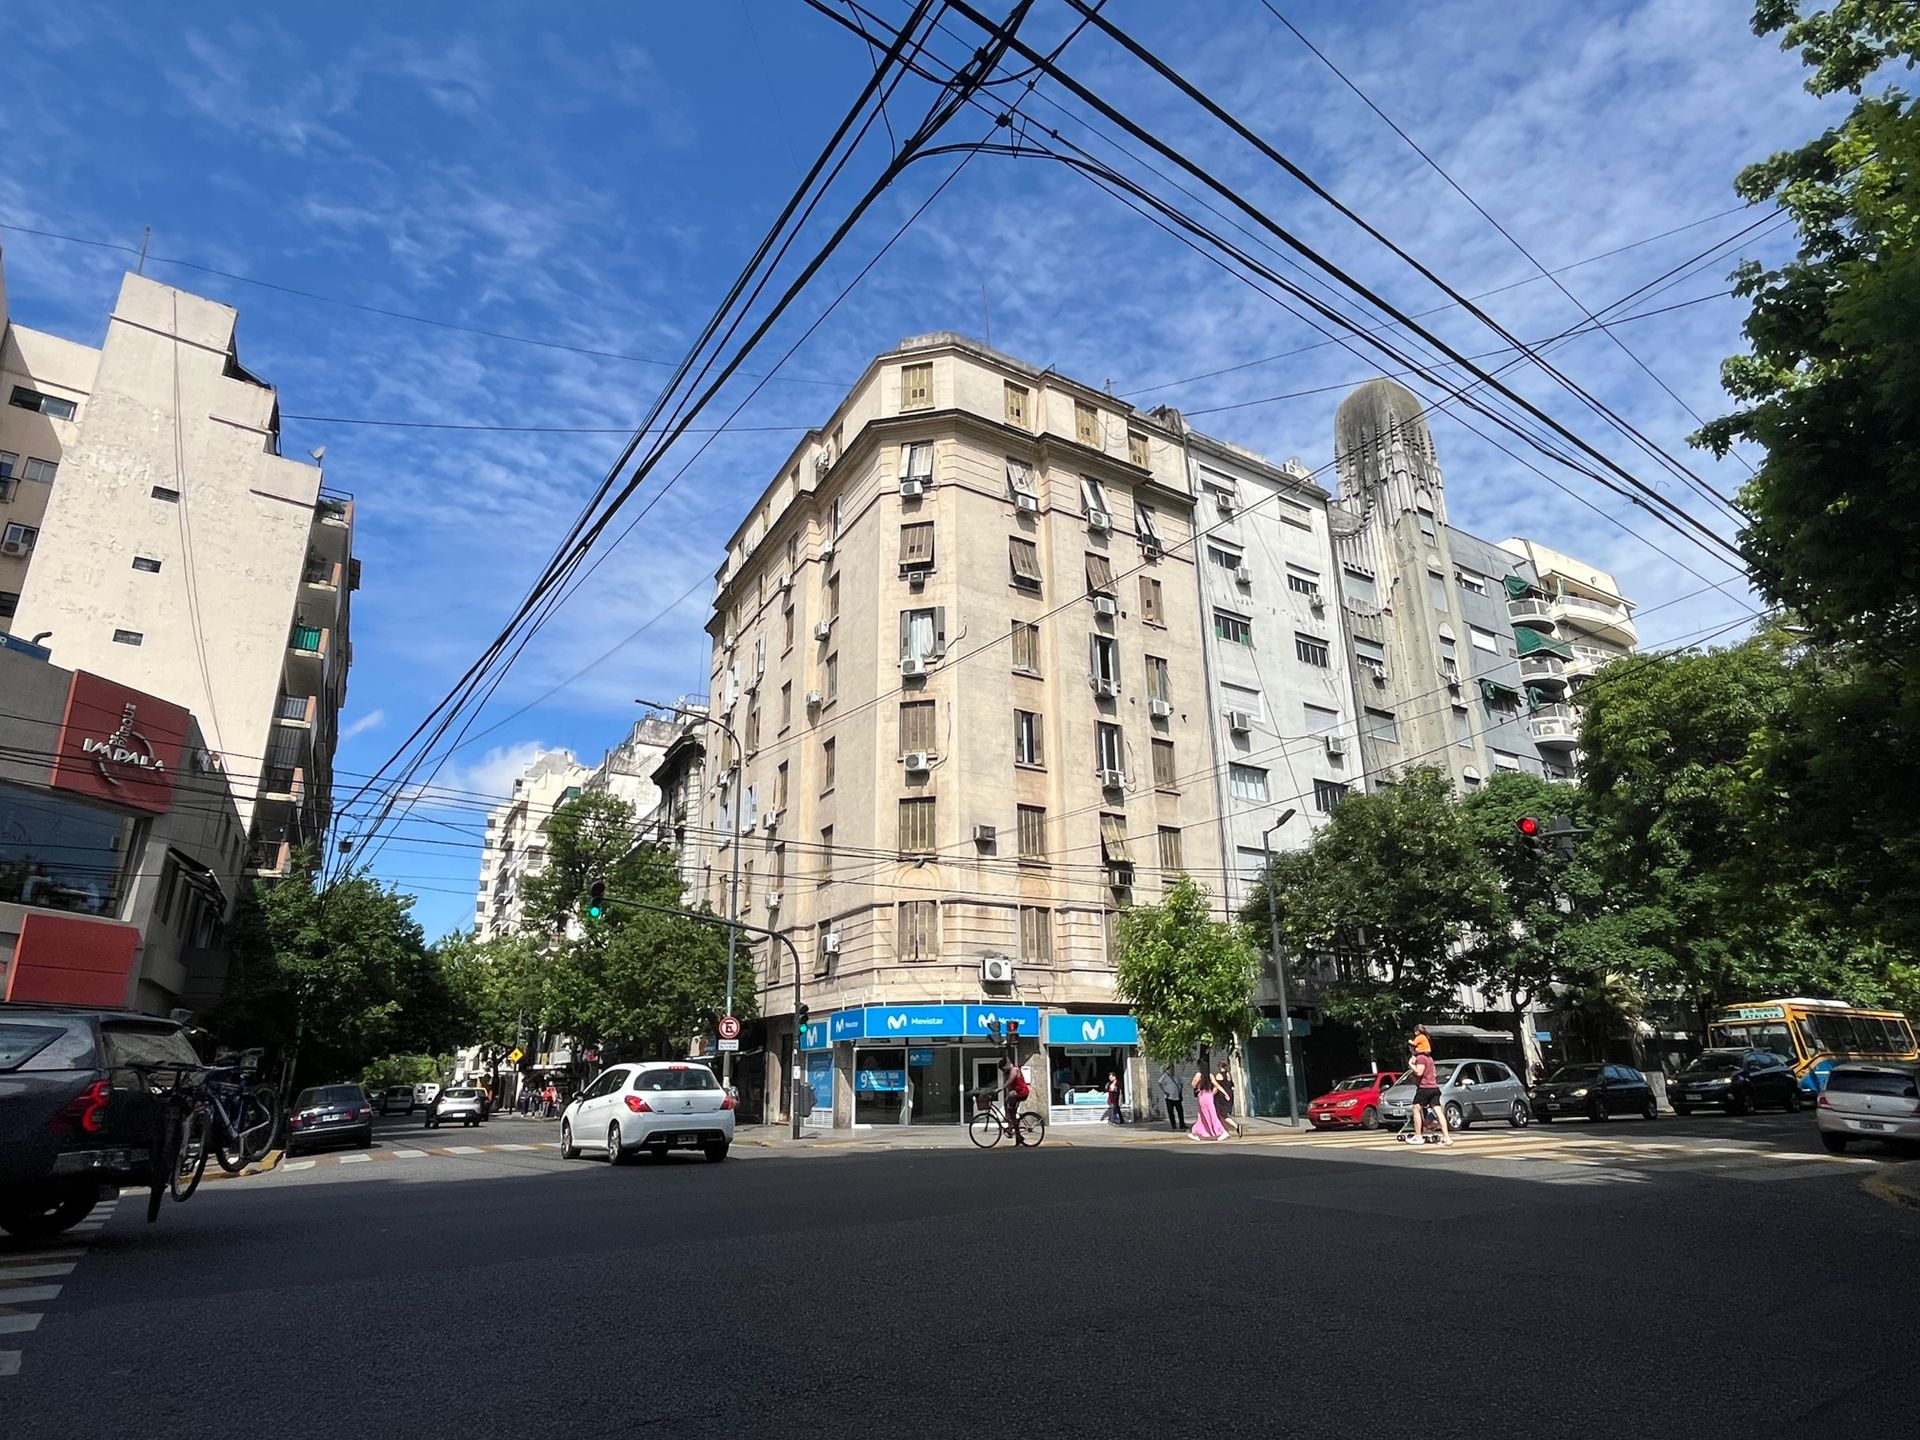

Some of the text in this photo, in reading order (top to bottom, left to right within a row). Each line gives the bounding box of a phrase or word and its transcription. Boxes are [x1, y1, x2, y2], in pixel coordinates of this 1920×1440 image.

[82, 738, 165, 772] IMPALA
[911, 1017, 944, 1025] Movistar
[860, 1072, 868, 1089] 9
